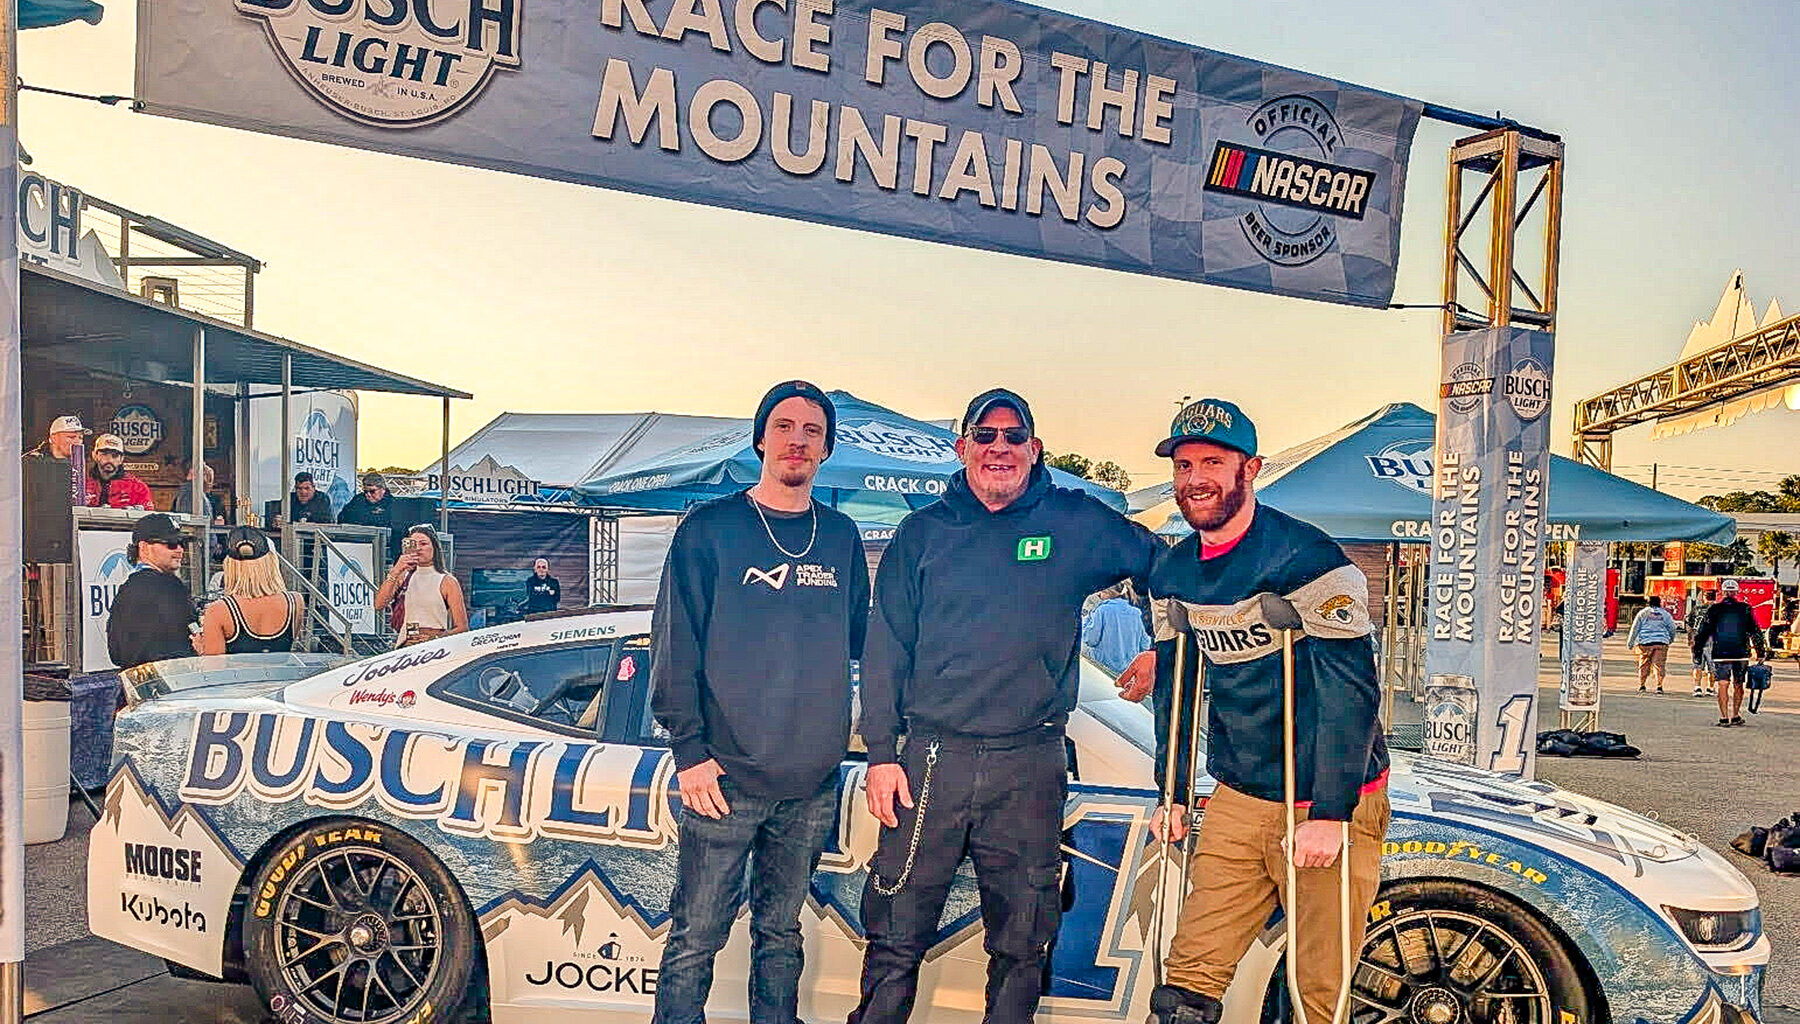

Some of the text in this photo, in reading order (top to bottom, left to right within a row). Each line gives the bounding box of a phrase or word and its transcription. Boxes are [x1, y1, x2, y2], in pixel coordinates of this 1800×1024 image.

[300, 25, 462, 88] LIGHT
[321, 73, 438, 101] BREWED IN U.S.A.
[864, 8, 1023, 114] FOR
[1051, 51, 1177, 144] THE
[591, 57, 1127, 229] MOUNTAINS
[1254, 104, 1338, 153] OFFICIAL
[1250, 155, 1368, 213] NASCAR
[1245, 211, 1331, 258] BEER SPONSOR
[1452, 379, 1493, 397] NASCAR
[1505, 375, 1551, 400] BUSCH
[1514, 397, 1541, 409] LIGHT
[110, 421, 160, 439] BUSCH
[296, 437, 339, 468] BUSCH
[864, 475, 920, 493] CRACK
[1024, 540, 1044, 557] H
[1434, 450, 1460, 641] RACE FOR THE
[1455, 465, 1481, 642] MOUNTAINS
[1499, 450, 1524, 642] RACE FOR THE
[1516, 468, 1541, 643] MOUNTAINS
[796, 565, 823, 573] APEX
[797, 572, 834, 580] TRADER
[797, 579, 838, 587] FUNDING
[333, 583, 371, 606] BUSCH
[1574, 567, 1587, 642] RACE FOR THE
[1586, 573, 1598, 643] MOUNTAINS
[550, 625, 616, 641] SIEMENS
[350, 688, 396, 707] Wendy's
[1424, 720, 1472, 744] BUSCH
[1431, 741, 1462, 754] LIGHT
[1489, 694, 1533, 778] 1
[184, 711, 682, 838] BUSCHLI
[124, 842, 202, 883] MOOSE
[121, 891, 207, 933] Kubota
[572, 951, 645, 963] SINCE 1876
[525, 960, 660, 995] JOCKE
